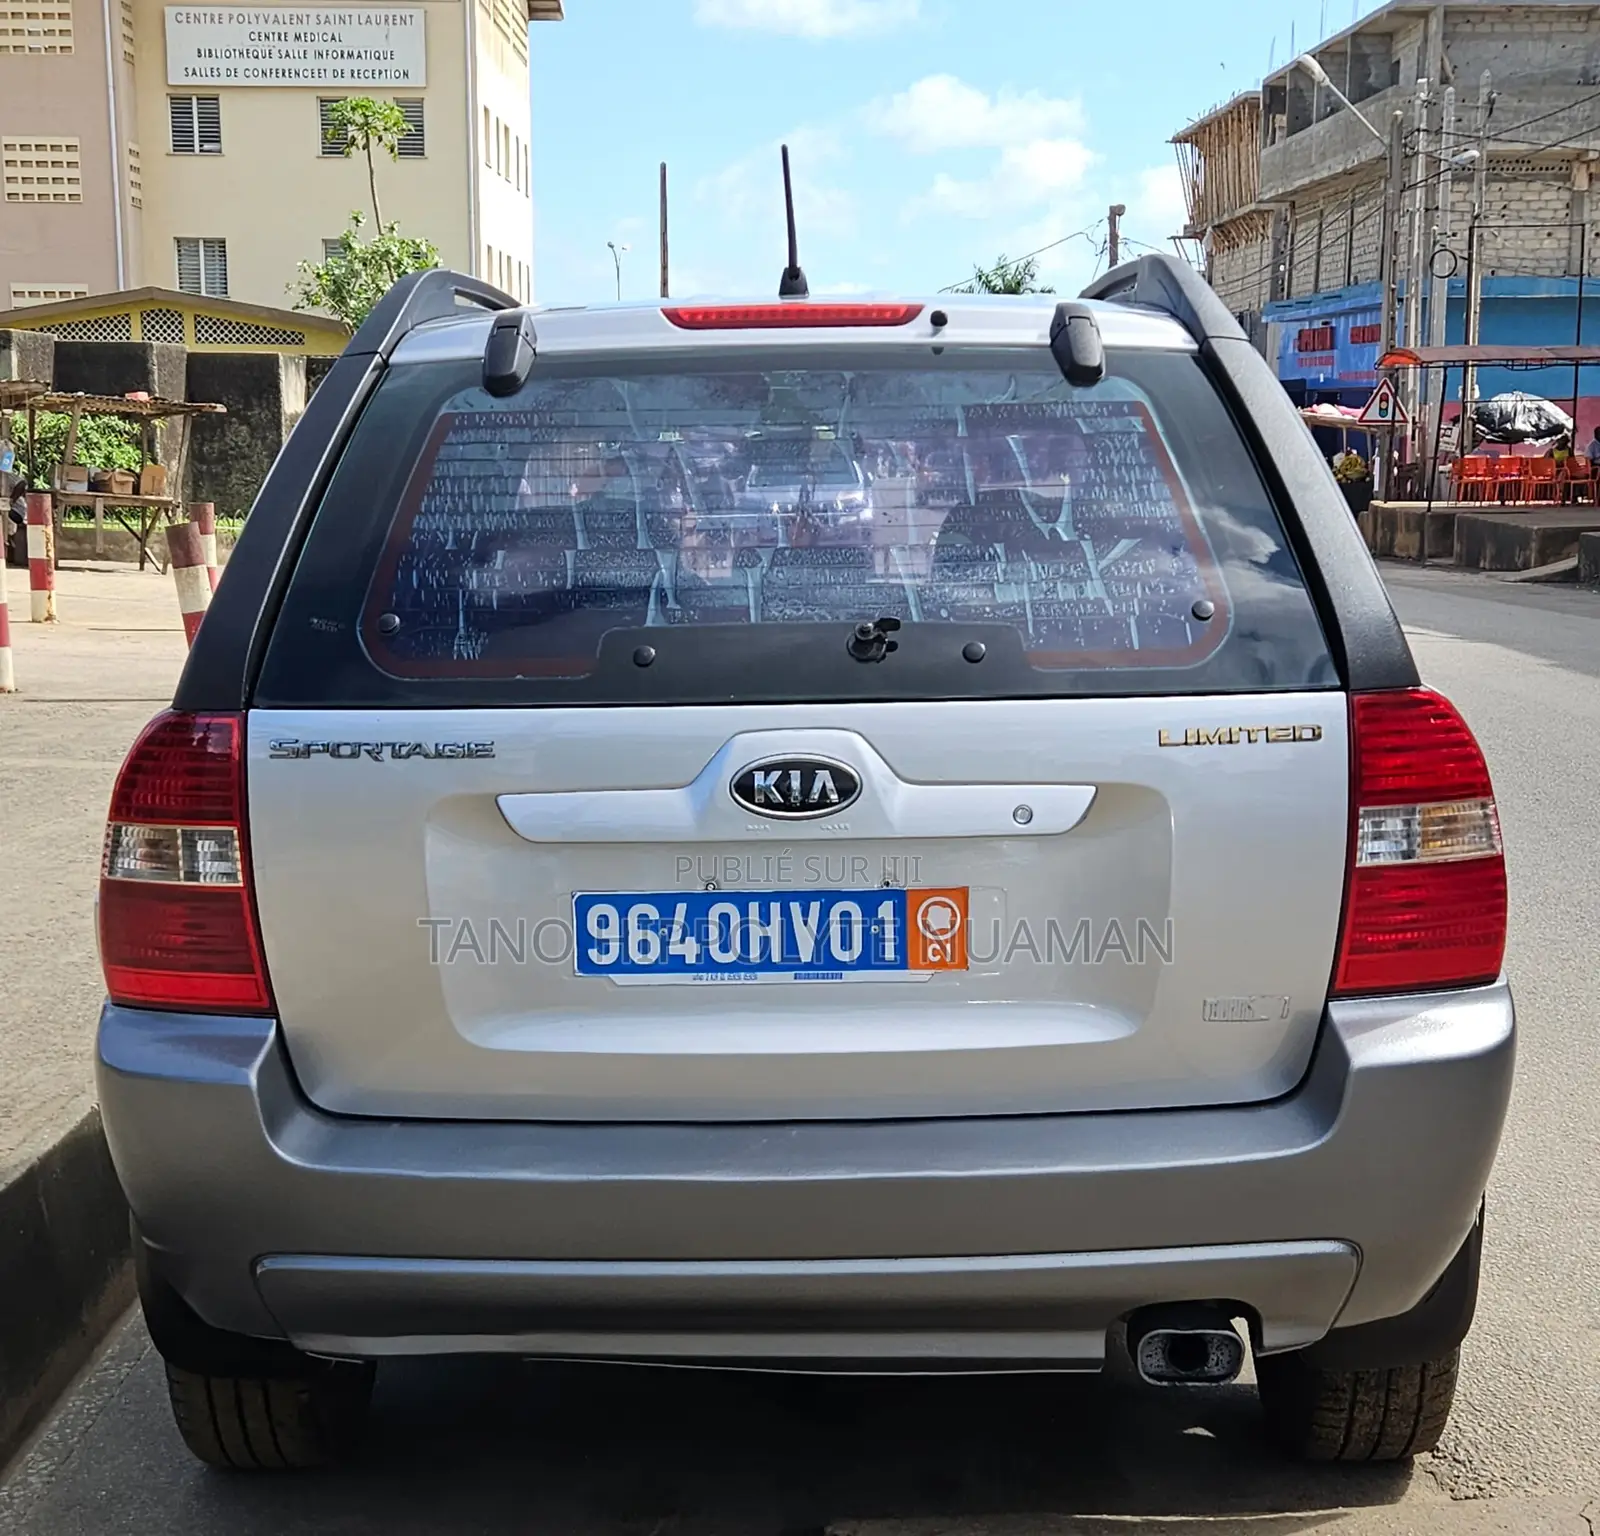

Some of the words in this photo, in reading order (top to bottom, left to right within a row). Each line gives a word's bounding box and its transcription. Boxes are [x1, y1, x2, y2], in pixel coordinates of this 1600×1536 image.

[174, 12, 225, 25] CENTRE
[228, 14, 311, 26] POLYVALENT
[315, 14, 353, 26] SAINT
[357, 14, 415, 26] LAURENT
[248, 31, 289, 43] CENTRE
[293, 32, 343, 44] MEDICAL
[196, 47, 273, 60] BIBLIOTHEQUE
[277, 49, 308, 60] SALLE
[313, 49, 395, 61] INFORMATIQUE
[184, 67, 222, 78] SALLES
[225, 67, 239, 78] DE
[332, 68, 346, 79] DE
[350, 69, 410, 80] RECEPTION
[1158, 724, 1323, 747] LIMITED
[268, 738, 497, 762] SPORTAGE
[752, 769, 839, 803] KIA
